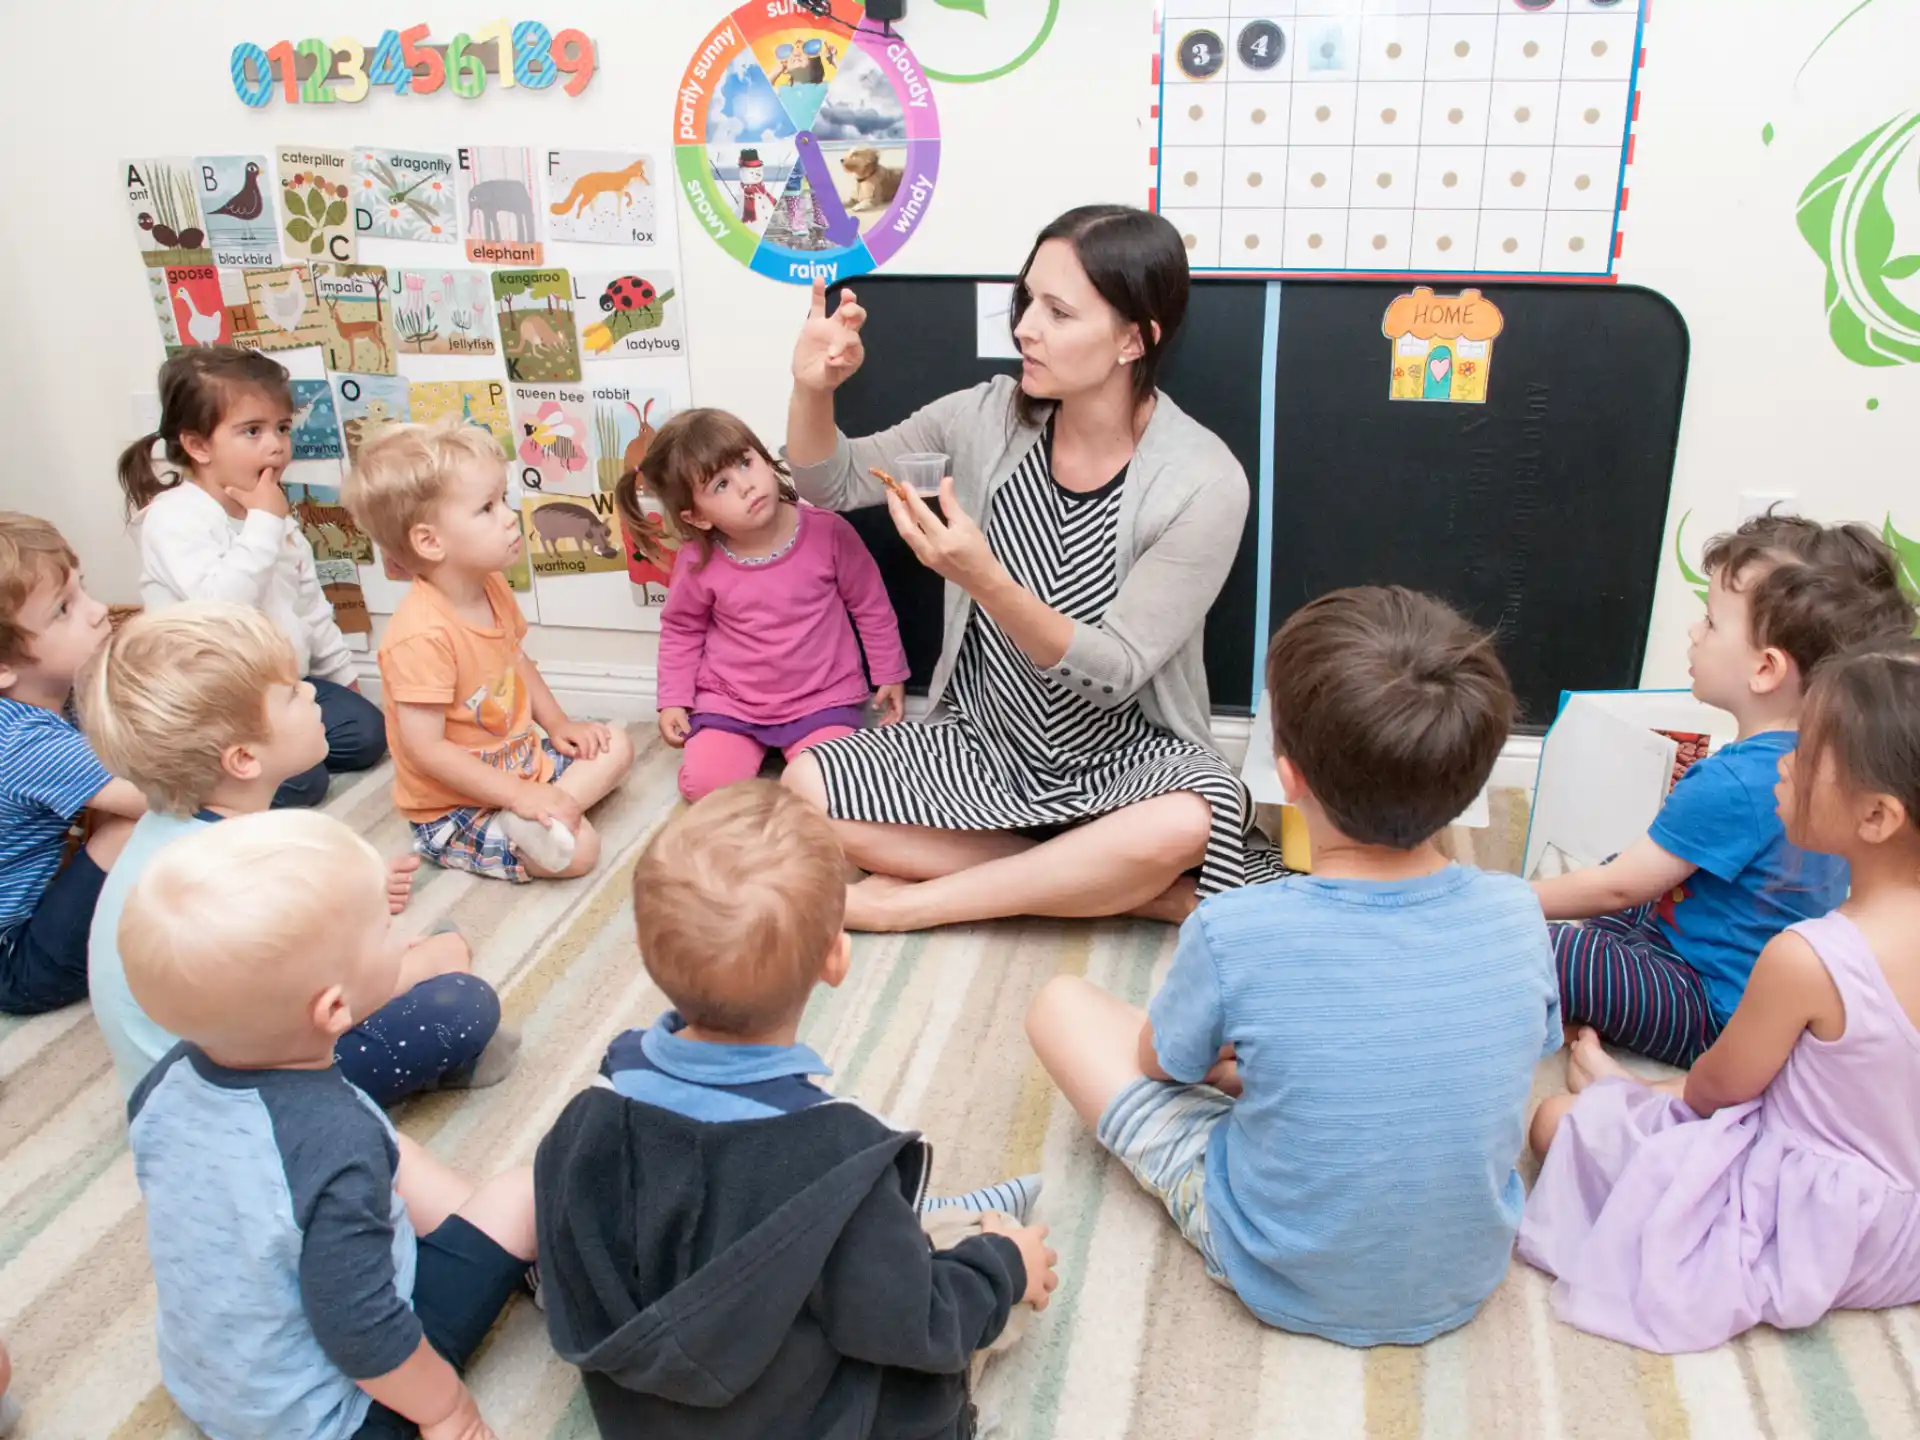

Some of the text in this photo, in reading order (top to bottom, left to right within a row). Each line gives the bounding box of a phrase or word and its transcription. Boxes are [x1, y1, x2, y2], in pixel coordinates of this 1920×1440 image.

[1191, 43, 1211, 66] 3
[1250, 34, 1269, 57] 4
[680, 25, 737, 140] partly sunny
[886, 43, 928, 109] cloudy
[282, 152, 345, 168] caterpillar
[391, 156, 452, 174] dragonfly
[458, 148, 470, 170] E
[548, 152, 560, 176] F
[127, 164, 146, 188] A
[202, 166, 218, 191] B
[129, 187, 149, 201] ant
[893, 173, 934, 235] windy
[356, 208, 373, 231] D
[687, 179, 731, 240] snowy
[632, 228, 653, 242] fox
[218, 252, 273, 265] blackbird
[329, 235, 350, 261] C
[473, 247, 535, 262] elephant
[167, 267, 214, 285] goose
[499, 272, 560, 285] kangaroo
[789, 261, 838, 281] rainy
[320, 280, 363, 293] impala
[392, 273, 402, 294] J
[573, 277, 586, 300] L
[232, 308, 250, 332] H
[1413, 304, 1476, 325] HOME
[449, 337, 494, 350] jellyfish
[626, 337, 680, 350] ladybug
[507, 358, 524, 380] K
[341, 380, 361, 402] O
[489, 383, 502, 405] P
[516, 388, 584, 402] queen bee
[592, 388, 630, 400] rabbit
[522, 467, 541, 490] Q
[591, 493, 614, 515] W
[534, 560, 586, 572] warthog
